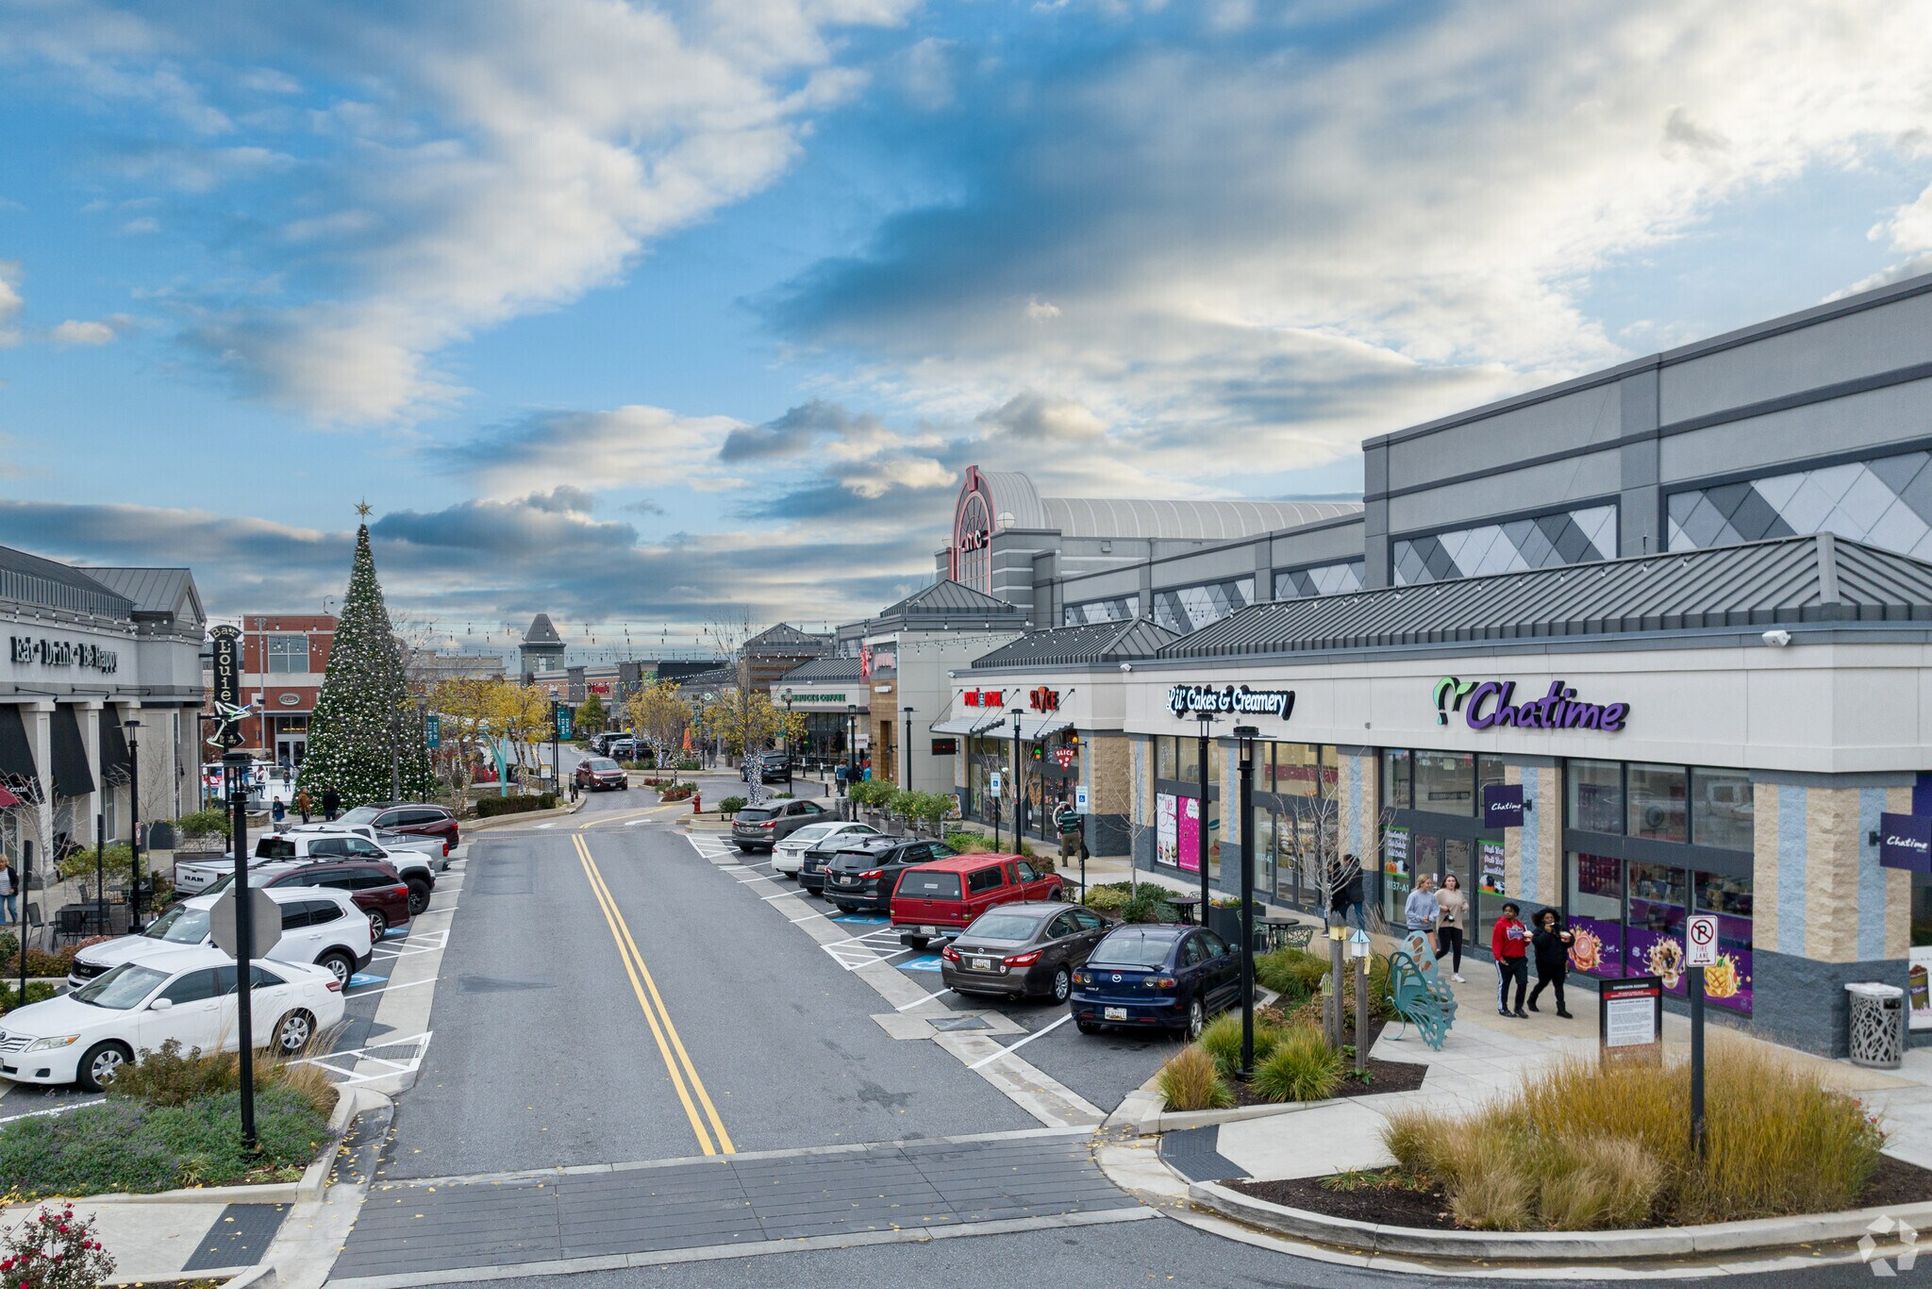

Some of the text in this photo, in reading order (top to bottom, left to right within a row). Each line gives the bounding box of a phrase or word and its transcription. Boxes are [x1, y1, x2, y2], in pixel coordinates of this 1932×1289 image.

[212, 627, 239, 638] Bar
[41, 639, 75, 665] Drink
[79, 643, 94, 667] Be
[94, 645, 117, 674] Happy
[219, 640, 232, 701] Louie
[781, 693, 846, 702] SRBUCKS COFFEE
[1166, 687, 1287, 717] Lil' Cakes & Creamery
[1466, 680, 1629, 731] Chatime
[1491, 802, 1521, 812] Chatime
[1886, 835, 1928, 849] Chatime
[1386, 879, 1409, 892] 8137-A1
[1696, 945, 1708, 953] FIRE
